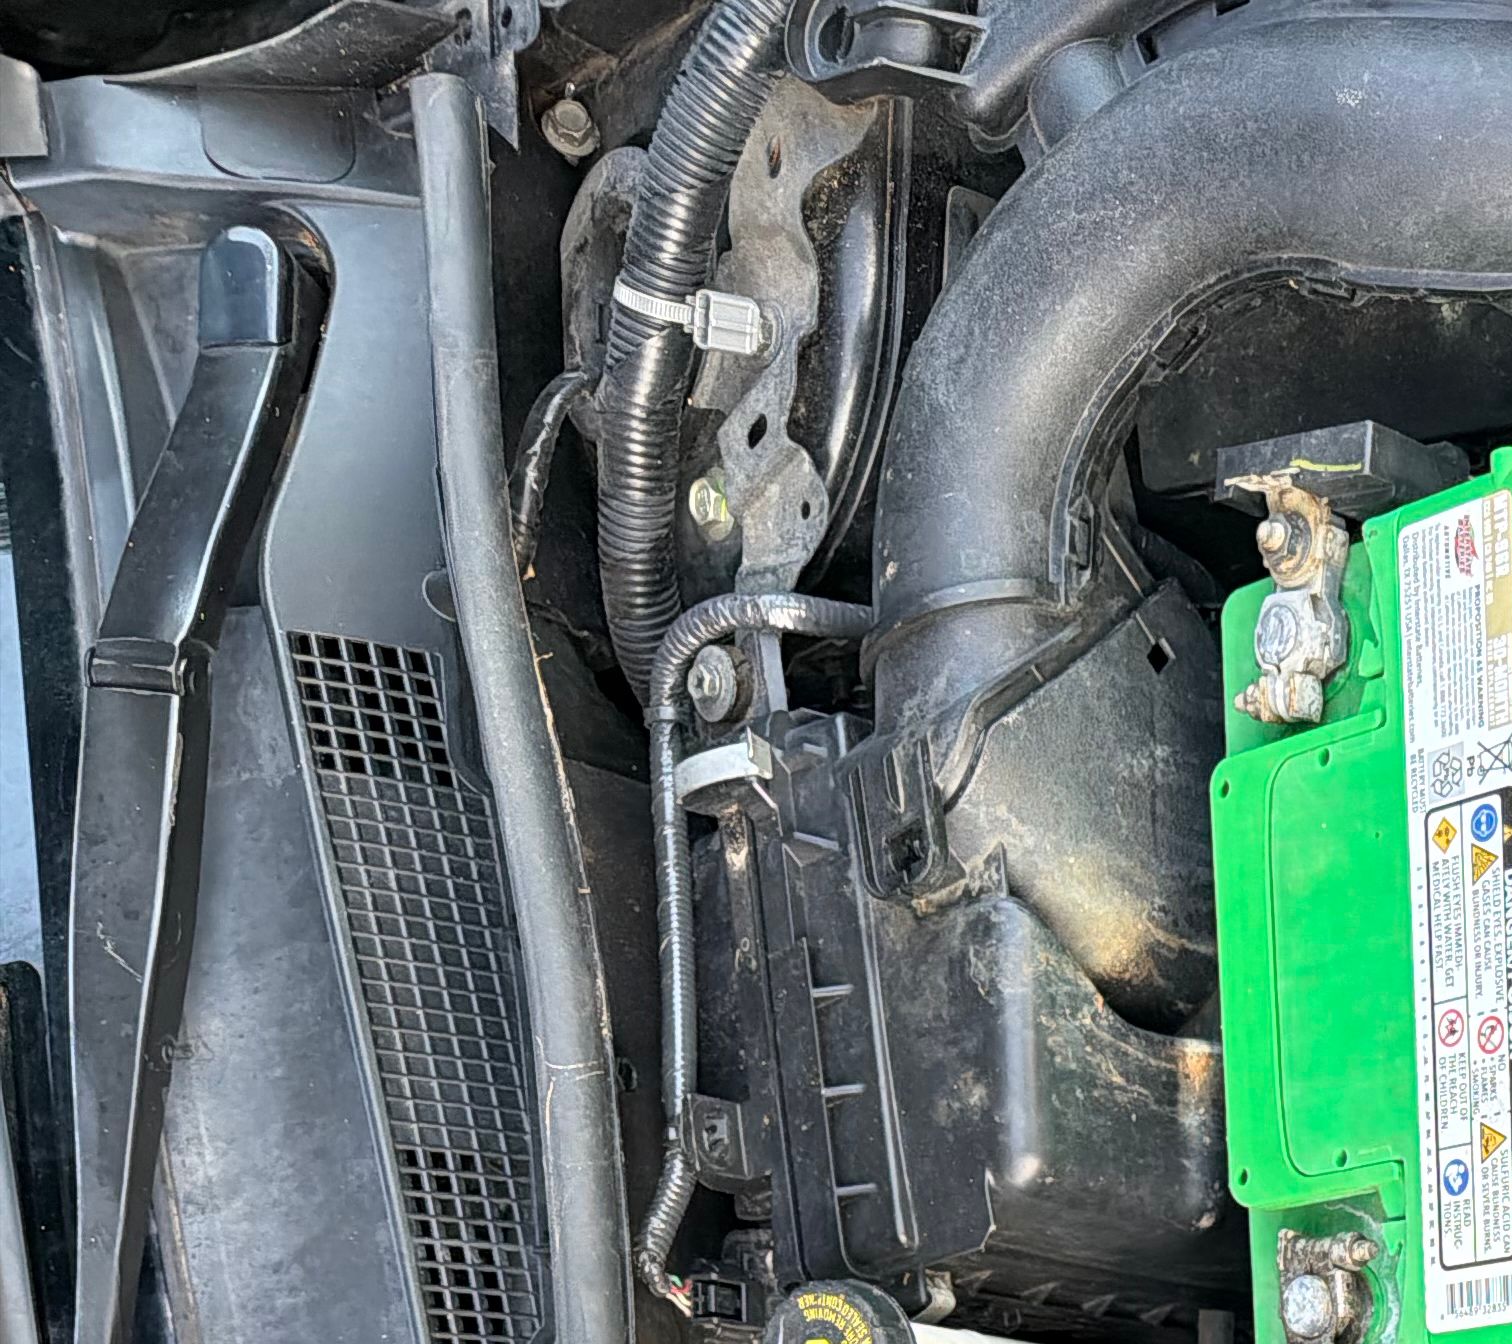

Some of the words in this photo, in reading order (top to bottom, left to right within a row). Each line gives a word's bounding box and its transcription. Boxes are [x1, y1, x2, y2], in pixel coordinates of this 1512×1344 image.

[1474, 584, 1483, 657] PROPOSITION
[1467, 756, 1475, 777] Pb
[1411, 768, 1419, 813] RECYCLED
[1432, 861, 1441, 911] MEDICAL
[1442, 859, 1451, 889] ATELY
[1451, 856, 1460, 891] FLUSH
[1492, 867, 1501, 908] SHIELD
[1443, 891, 1452, 921] WITH
[1453, 894, 1462, 920] EYES
[1482, 880, 1491, 915] GASES
[1434, 914, 1443, 941] HELP
[1472, 890, 1482, 943] BLINDNESS
[1483, 918, 1491, 938] CAN
[1474, 945, 1482, 959] OR
[1484, 941, 1492, 971] CAUSE
[1445, 968, 1454, 988] GET
[1475, 962, 1483, 1000] INJURY.
[1494, 943, 1504, 1003] EXPLOSIVE
[1439, 1057, 1447, 1070] OF
[1448, 1054, 1457, 1075] THE
[1458, 1052, 1466, 1079] KEEP
[1498, 1054, 1506, 1072] NO
[1449, 1080, 1458, 1115] REACH
[1459, 1083, 1467, 1104] OUT
[1472, 1068, 1480, 1115] SMOKING
[1481, 1067, 1489, 1103] FLAMES
[1489, 1065, 1497, 1101] SPARKS
[1460, 1107, 1468, 1121] OF
[1481, 1166, 1489, 1180] OR
[1491, 1158, 1499, 1187] CAUSE
[1500, 1149, 1510, 1203] SULFURIC
[1462, 1199, 1471, 1227] READ
[1482, 1182, 1491, 1216] SEVERE
[1453, 1200, 1463, 1250] INSTRUC-
[1492, 1190, 1501, 1242] BLINDNESS
[1502, 1205, 1511, 1231] ACID
[1503, 1234, 1511, 1254] CAN
[803, 1306, 847, 1330] REMOVING
[844, 1305, 868, 1340] SEALED
